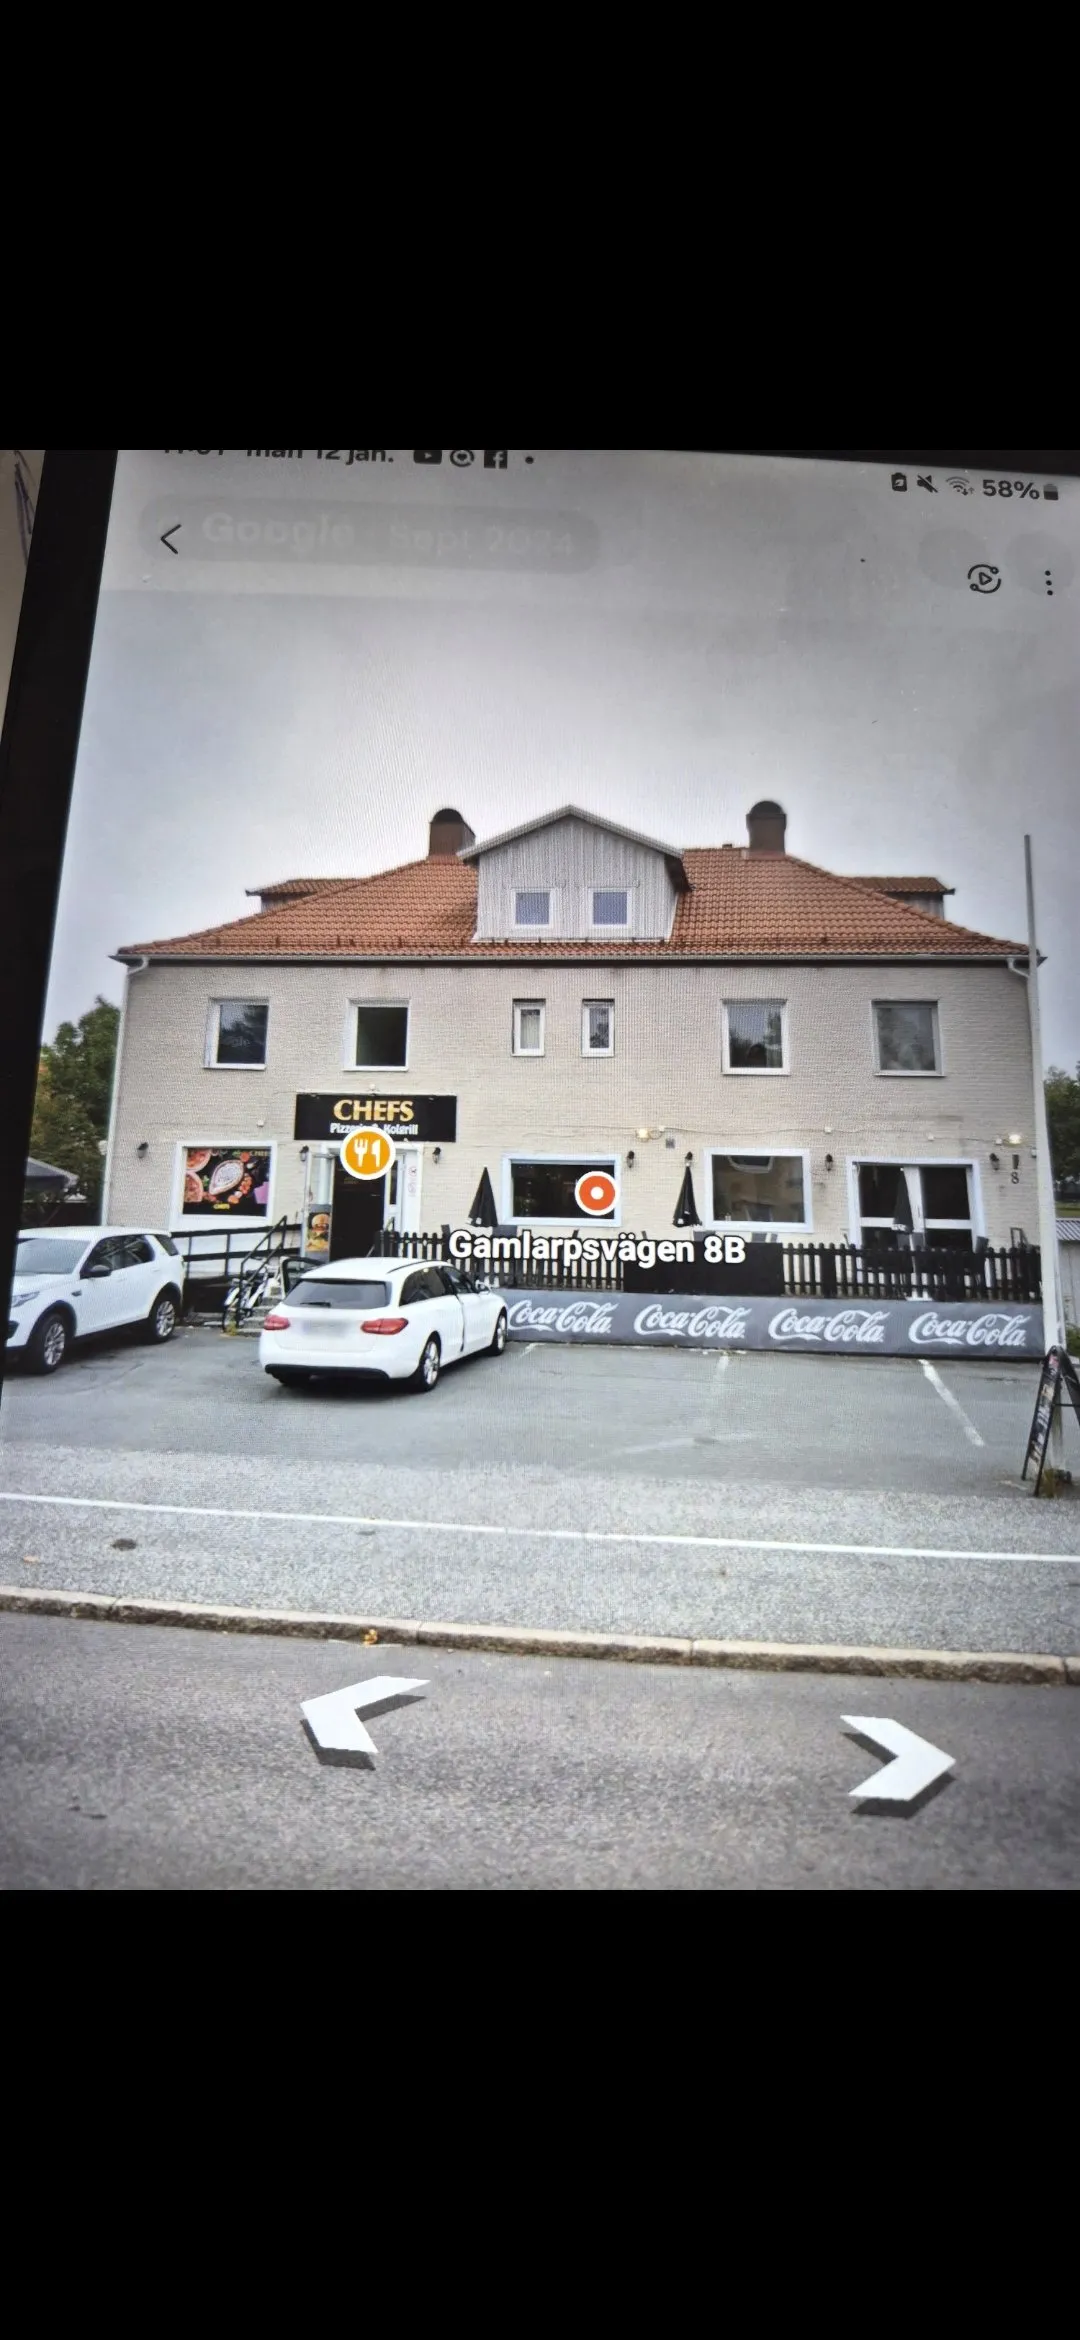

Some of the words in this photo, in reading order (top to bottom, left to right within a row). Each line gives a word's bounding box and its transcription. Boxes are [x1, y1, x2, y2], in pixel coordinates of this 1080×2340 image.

[982, 479, 1040, 500] 58%
[203, 512, 354, 553] Google
[333, 1099, 415, 1122] CHEFS
[1011, 1171, 1020, 1184] 8
[449, 1229, 695, 1269] Gamlarpsvägen
[703, 1235, 747, 1265] 8B
[507, 1299, 620, 1334] Coca-Cola
[634, 1303, 752, 1339] Coca-Cola
[768, 1308, 891, 1343] Coca-Cola
[908, 1311, 1032, 1347] Coca-Cola
